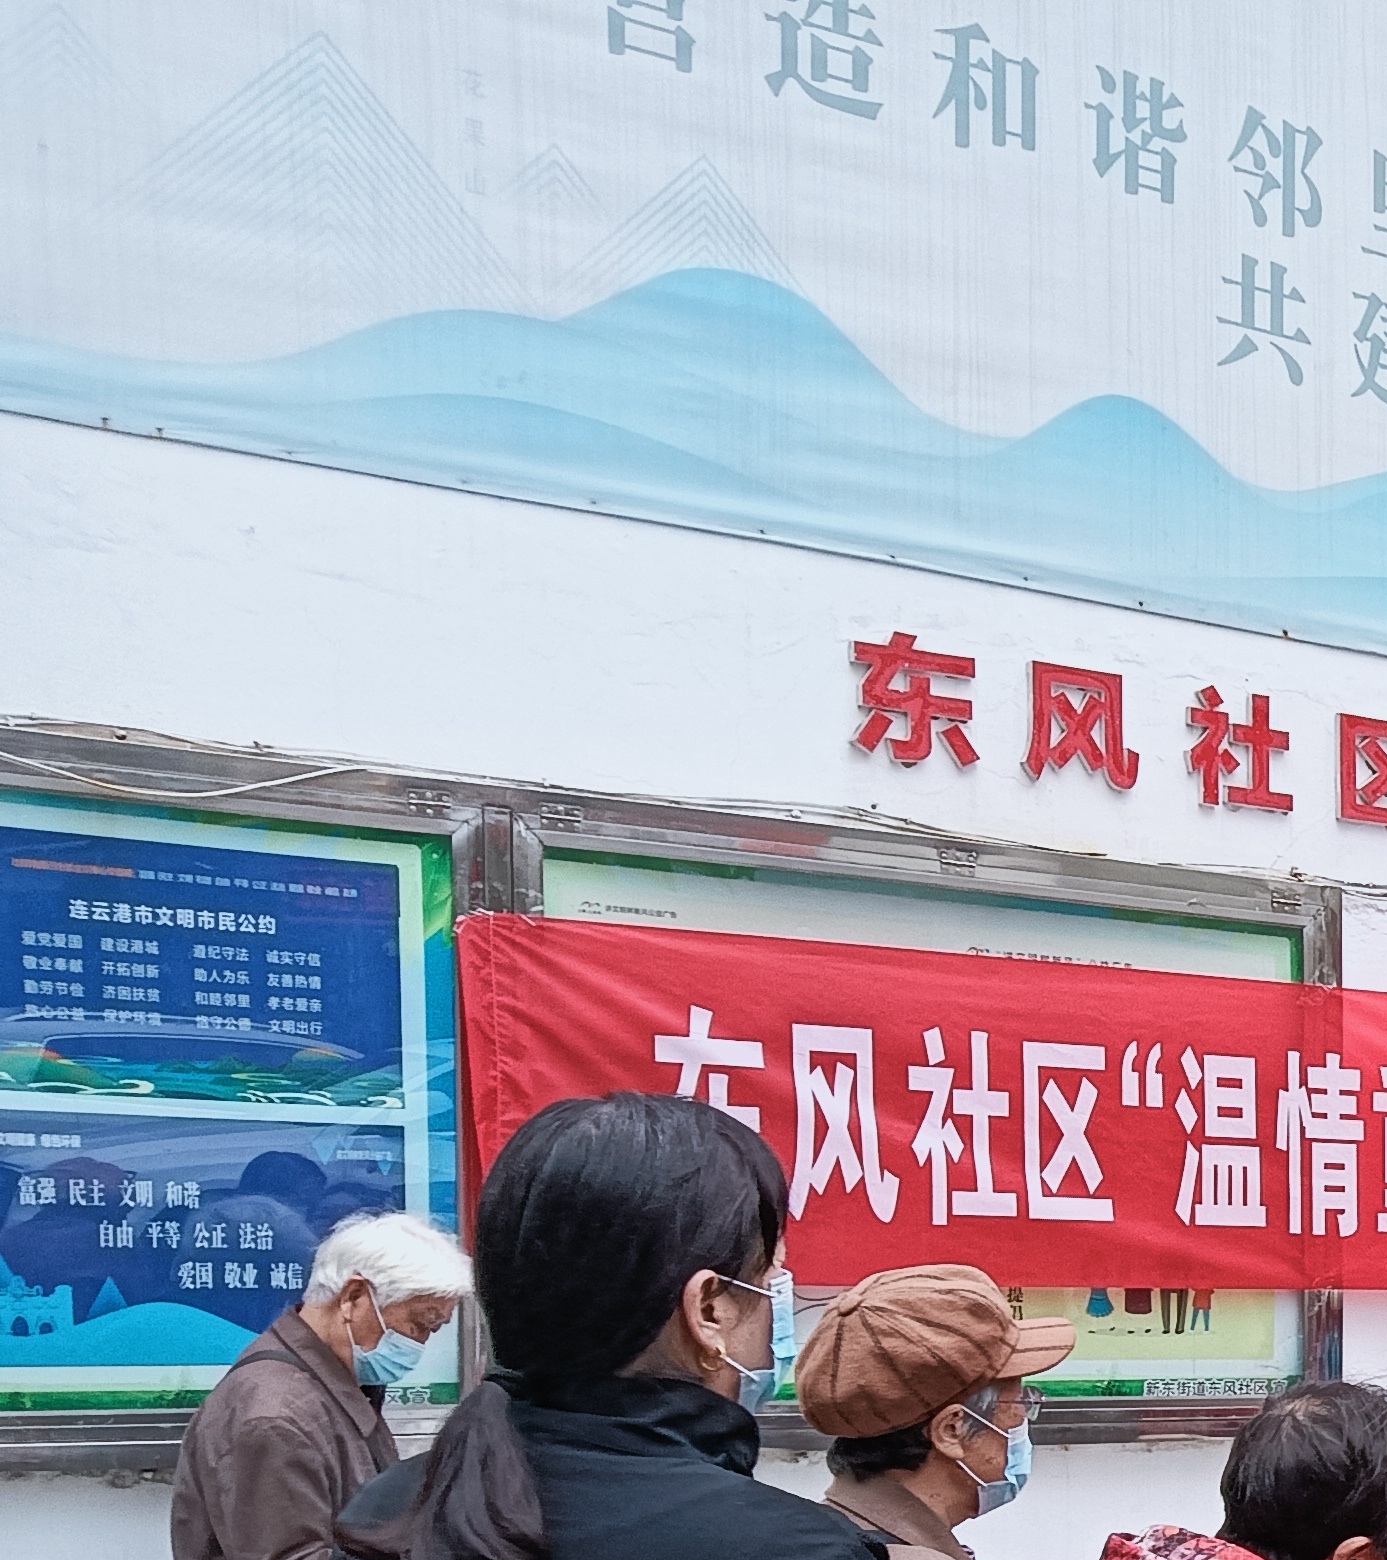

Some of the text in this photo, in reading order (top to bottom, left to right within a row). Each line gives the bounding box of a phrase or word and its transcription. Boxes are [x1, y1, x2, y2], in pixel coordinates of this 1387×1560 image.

[69, 899, 276, 934] 连云港市文明市民公约
[102, 961, 160, 978] 开拓创新
[194, 968, 250, 984] 助人为乐
[268, 1020, 323, 1036] 文明出行
[18, 1176, 200, 1209] 富强 民主 文明 和谐
[99, 1220, 273, 1250] 自由 平等 公正 法治
[178, 1262, 303, 1290] 爱国 敬业 诚信
